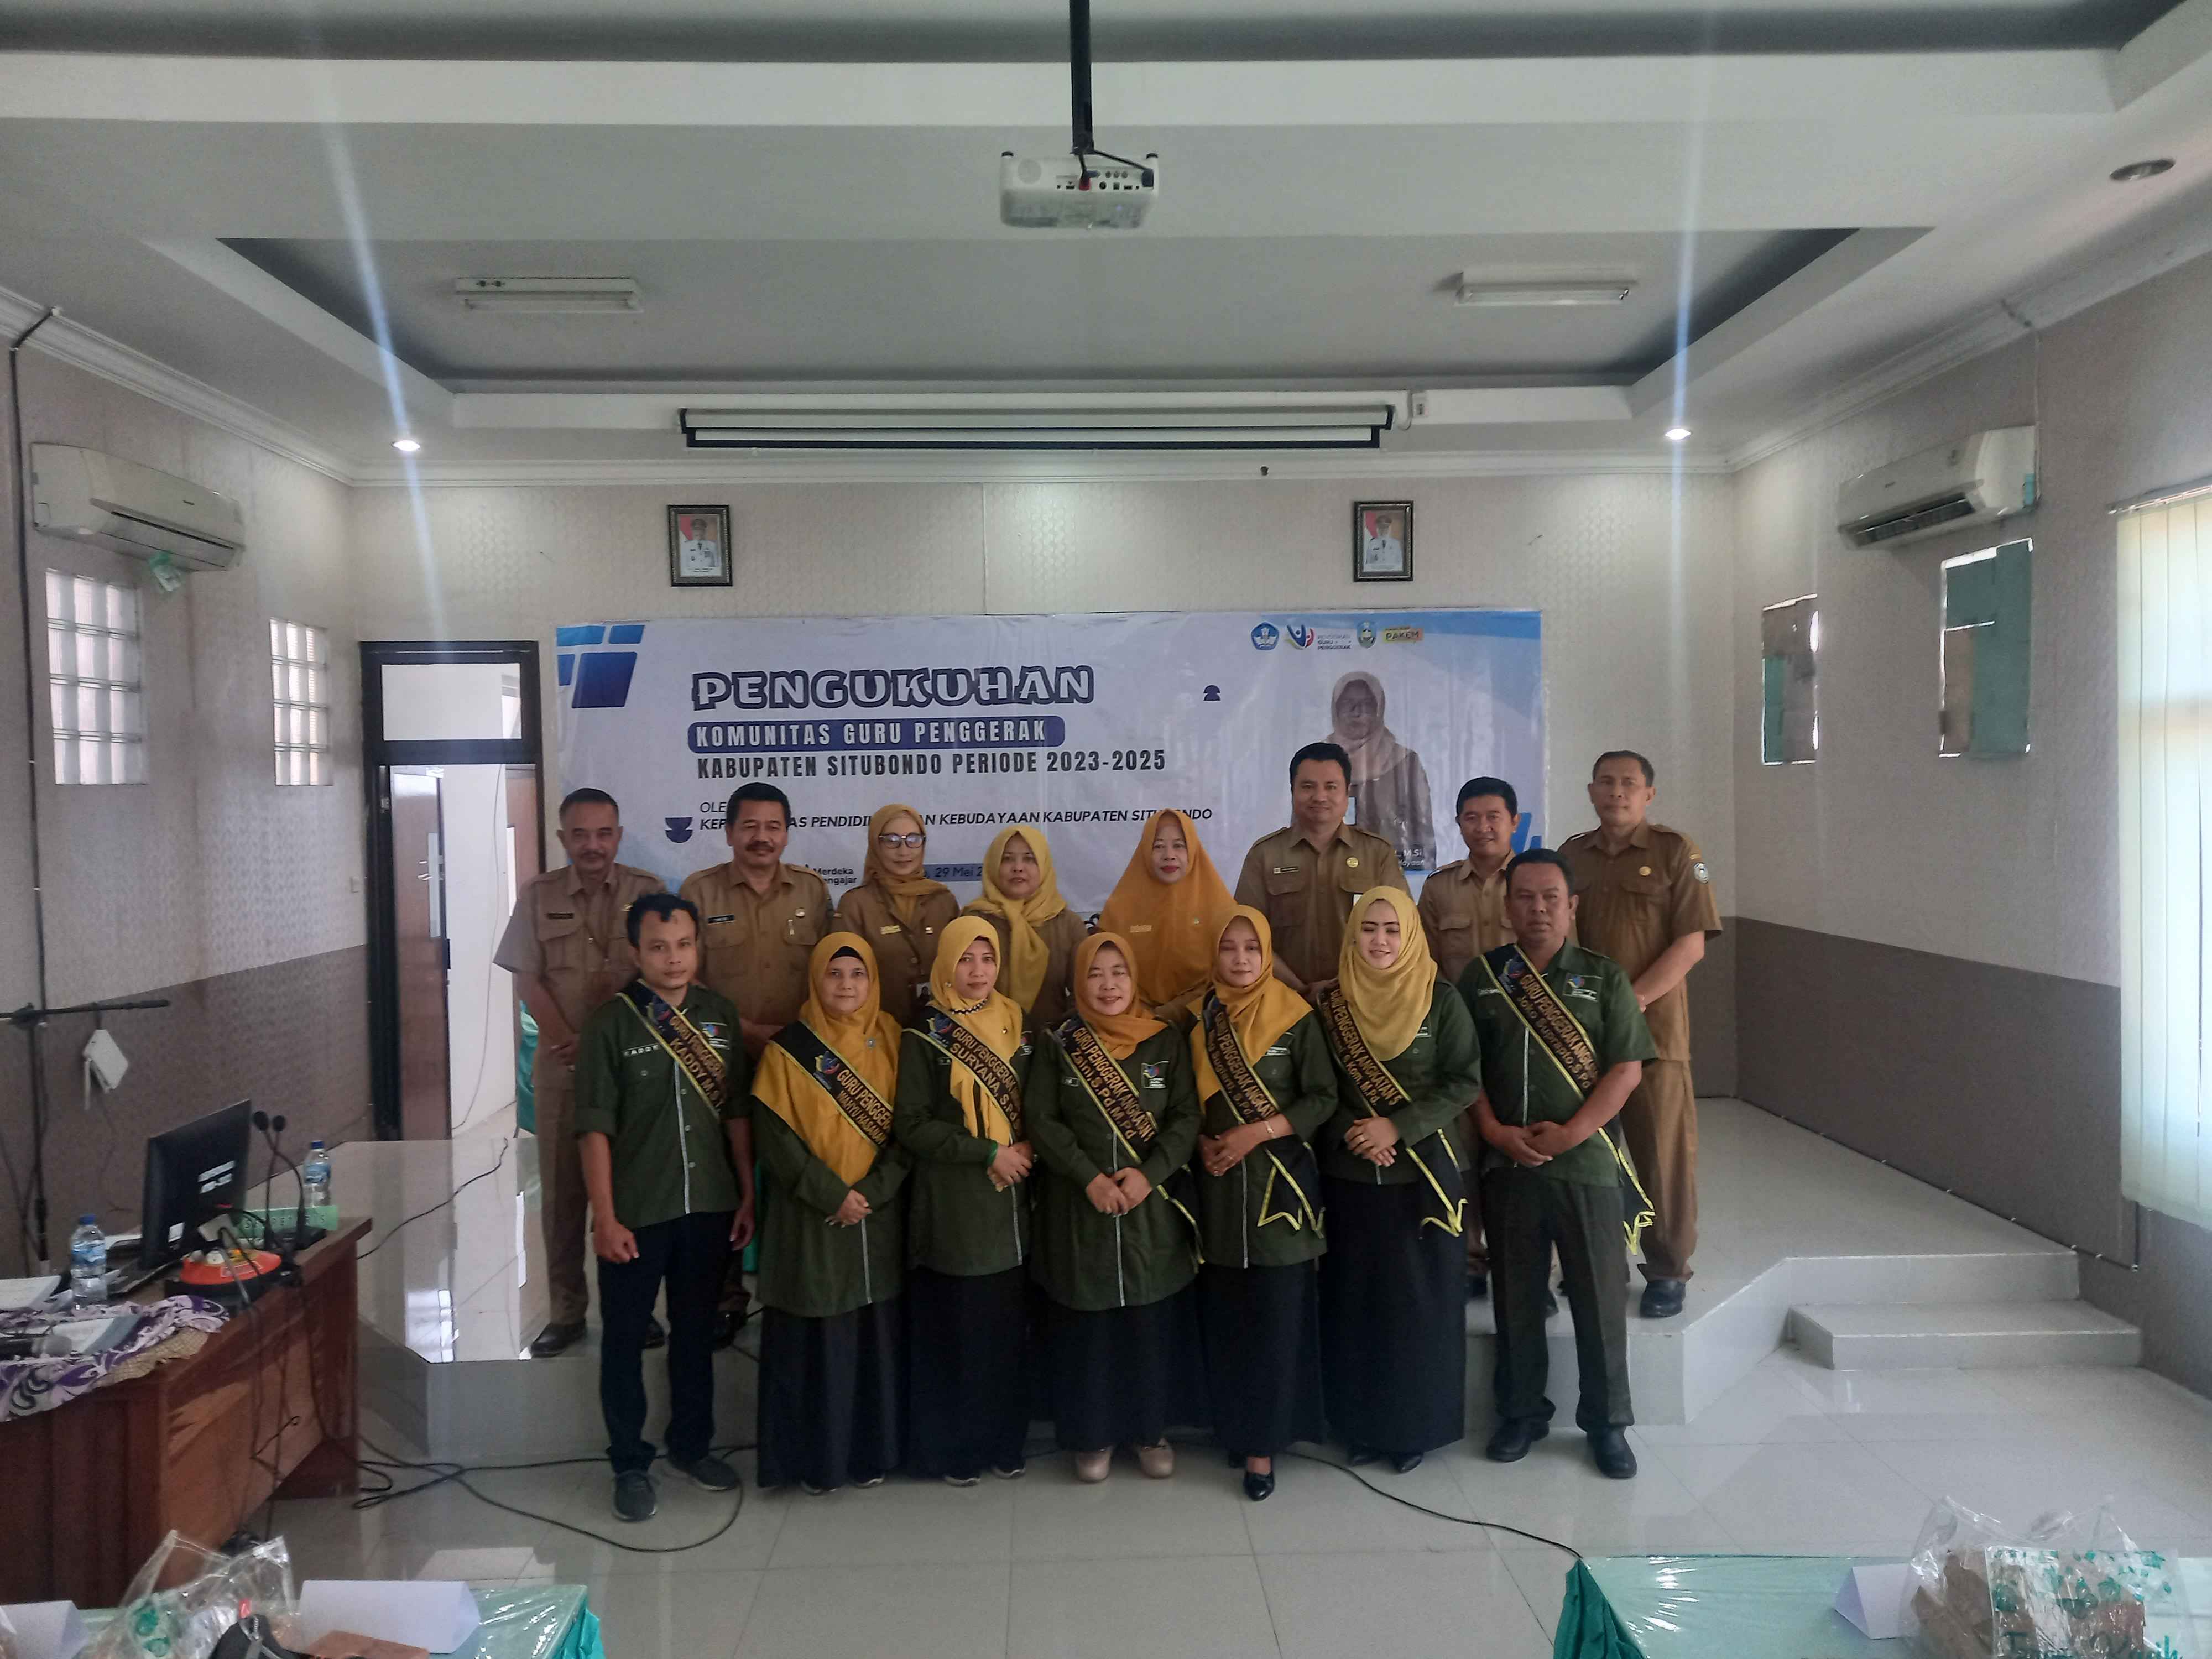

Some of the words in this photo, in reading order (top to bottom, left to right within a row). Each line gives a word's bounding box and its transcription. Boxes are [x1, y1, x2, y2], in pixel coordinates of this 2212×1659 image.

[692, 665, 1093, 711] PENGUKUHAN
[696, 724, 830, 747] KOMUNITAS
[843, 723, 901, 744] GURU
[915, 720, 1045, 743] PENGGERAK
[698, 757, 816, 778] KABUPATEN
[828, 754, 941, 776] SITUBONDO
[953, 752, 1037, 773] PERIODE
[1047, 749, 1165, 771] 2023-2025
[700, 802, 727, 813] OLE
[811, 816, 872, 827] PENDIDI
[940, 812, 1040, 825] KEBUDAYAAN
[1043, 810, 1128, 823] KABUPATEN
[823, 876, 857, 885] engajar
[935, 867, 950, 877] 29
[953, 867, 974, 877] Mei
[952, 1027, 978, 1049] GURU
[975, 1045, 1016, 1092] PENGGERAK
[1072, 1027, 1095, 1051] GURU
[1087, 1046, 1130, 1098] PENGGERAK
[1218, 1035, 1254, 1088] PENGGERAK
[1334, 1006, 1366, 1058] PENGGERAK
[1356, 1055, 1398, 1100] ANGKATAN
[837, 1069, 863, 1097] GURU
[950, 1043, 1001, 1097] SURYANA,
